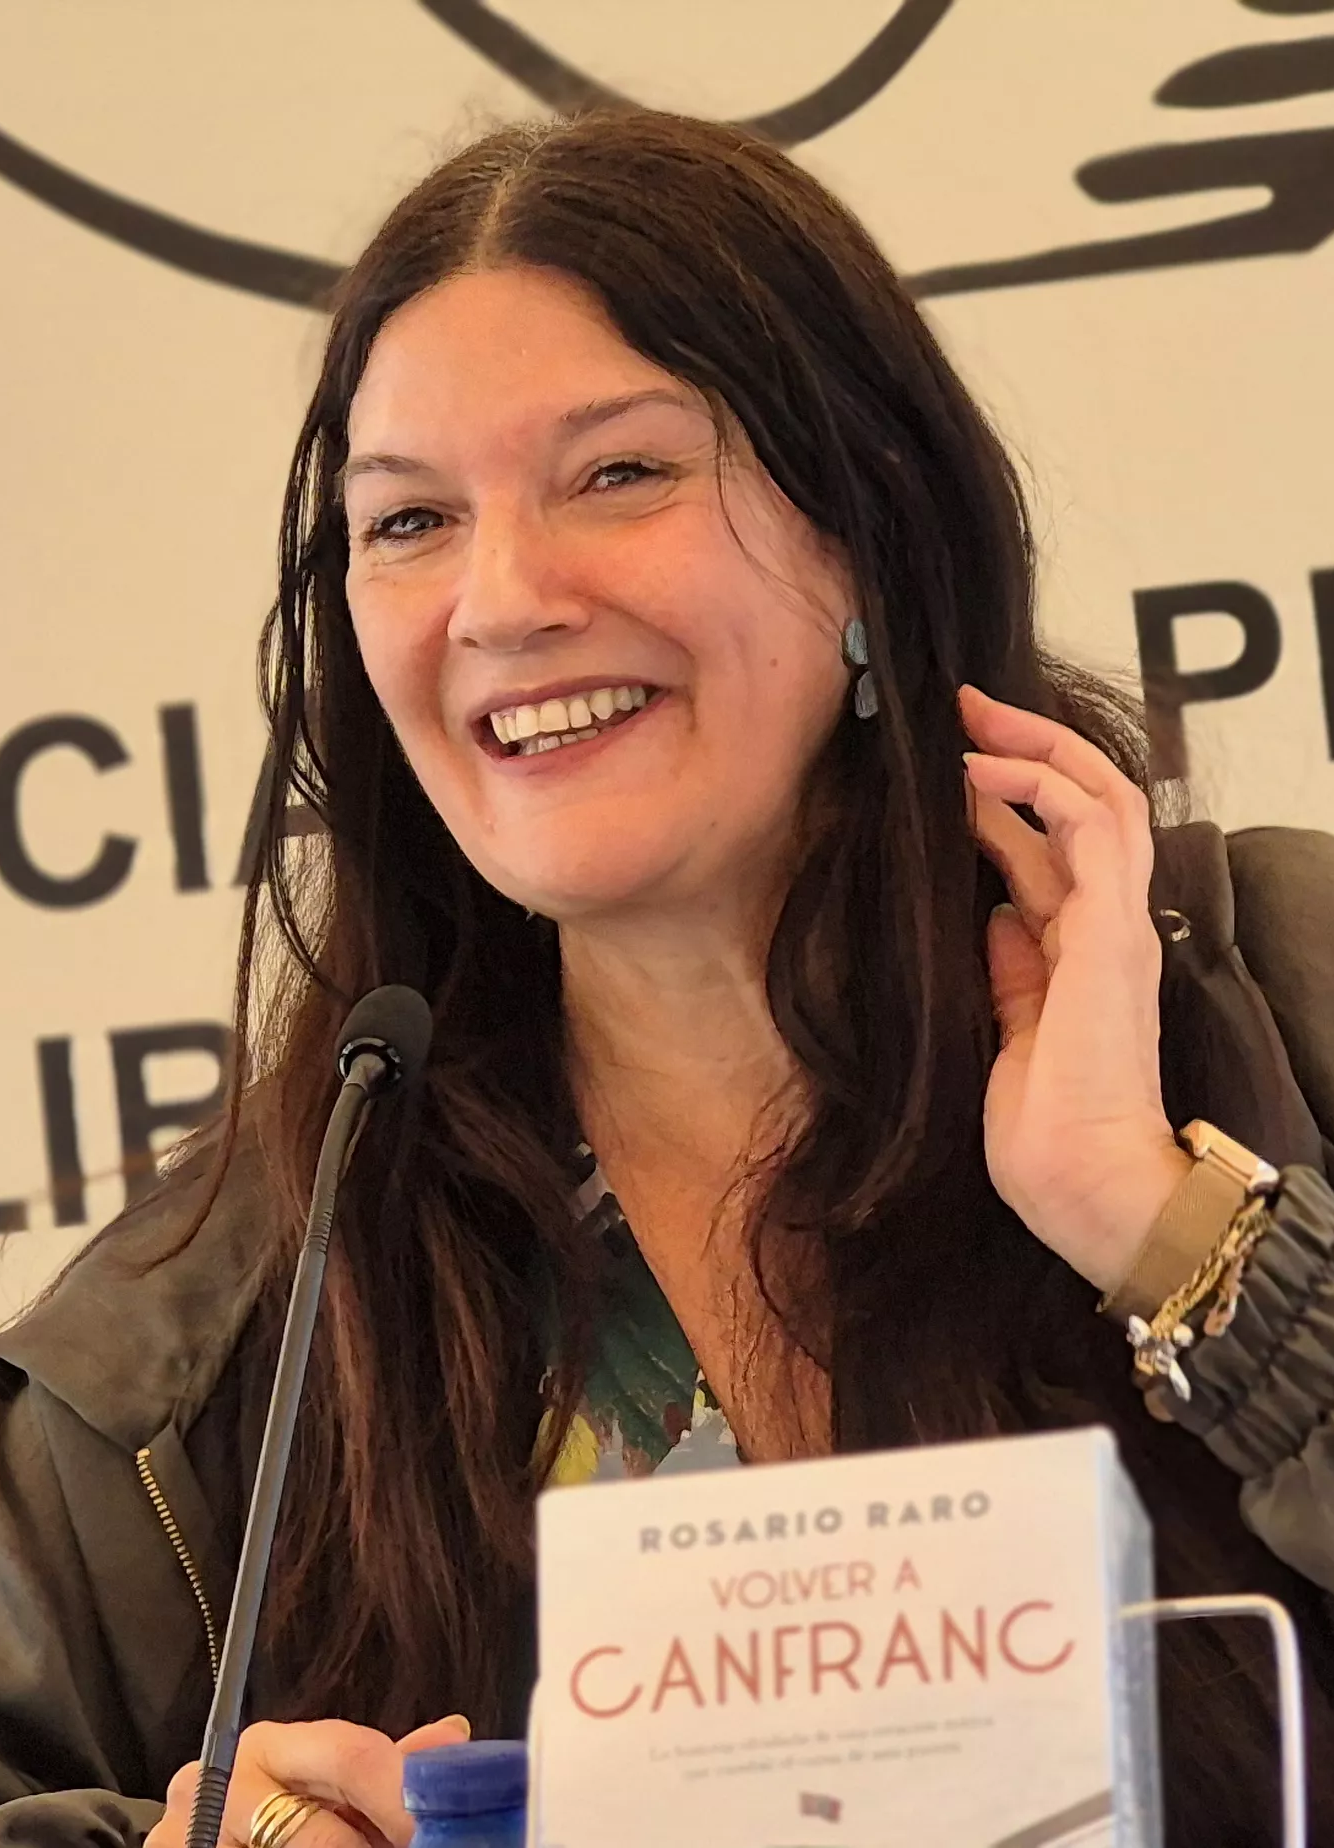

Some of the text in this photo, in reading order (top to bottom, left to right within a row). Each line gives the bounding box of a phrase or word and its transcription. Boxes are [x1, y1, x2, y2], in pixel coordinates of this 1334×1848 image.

[638, 1490, 992, 1553] ROSARIO RARO
[708, 1556, 924, 1610] VOLVER A
[568, 1599, 1077, 1719] CANFRANC
